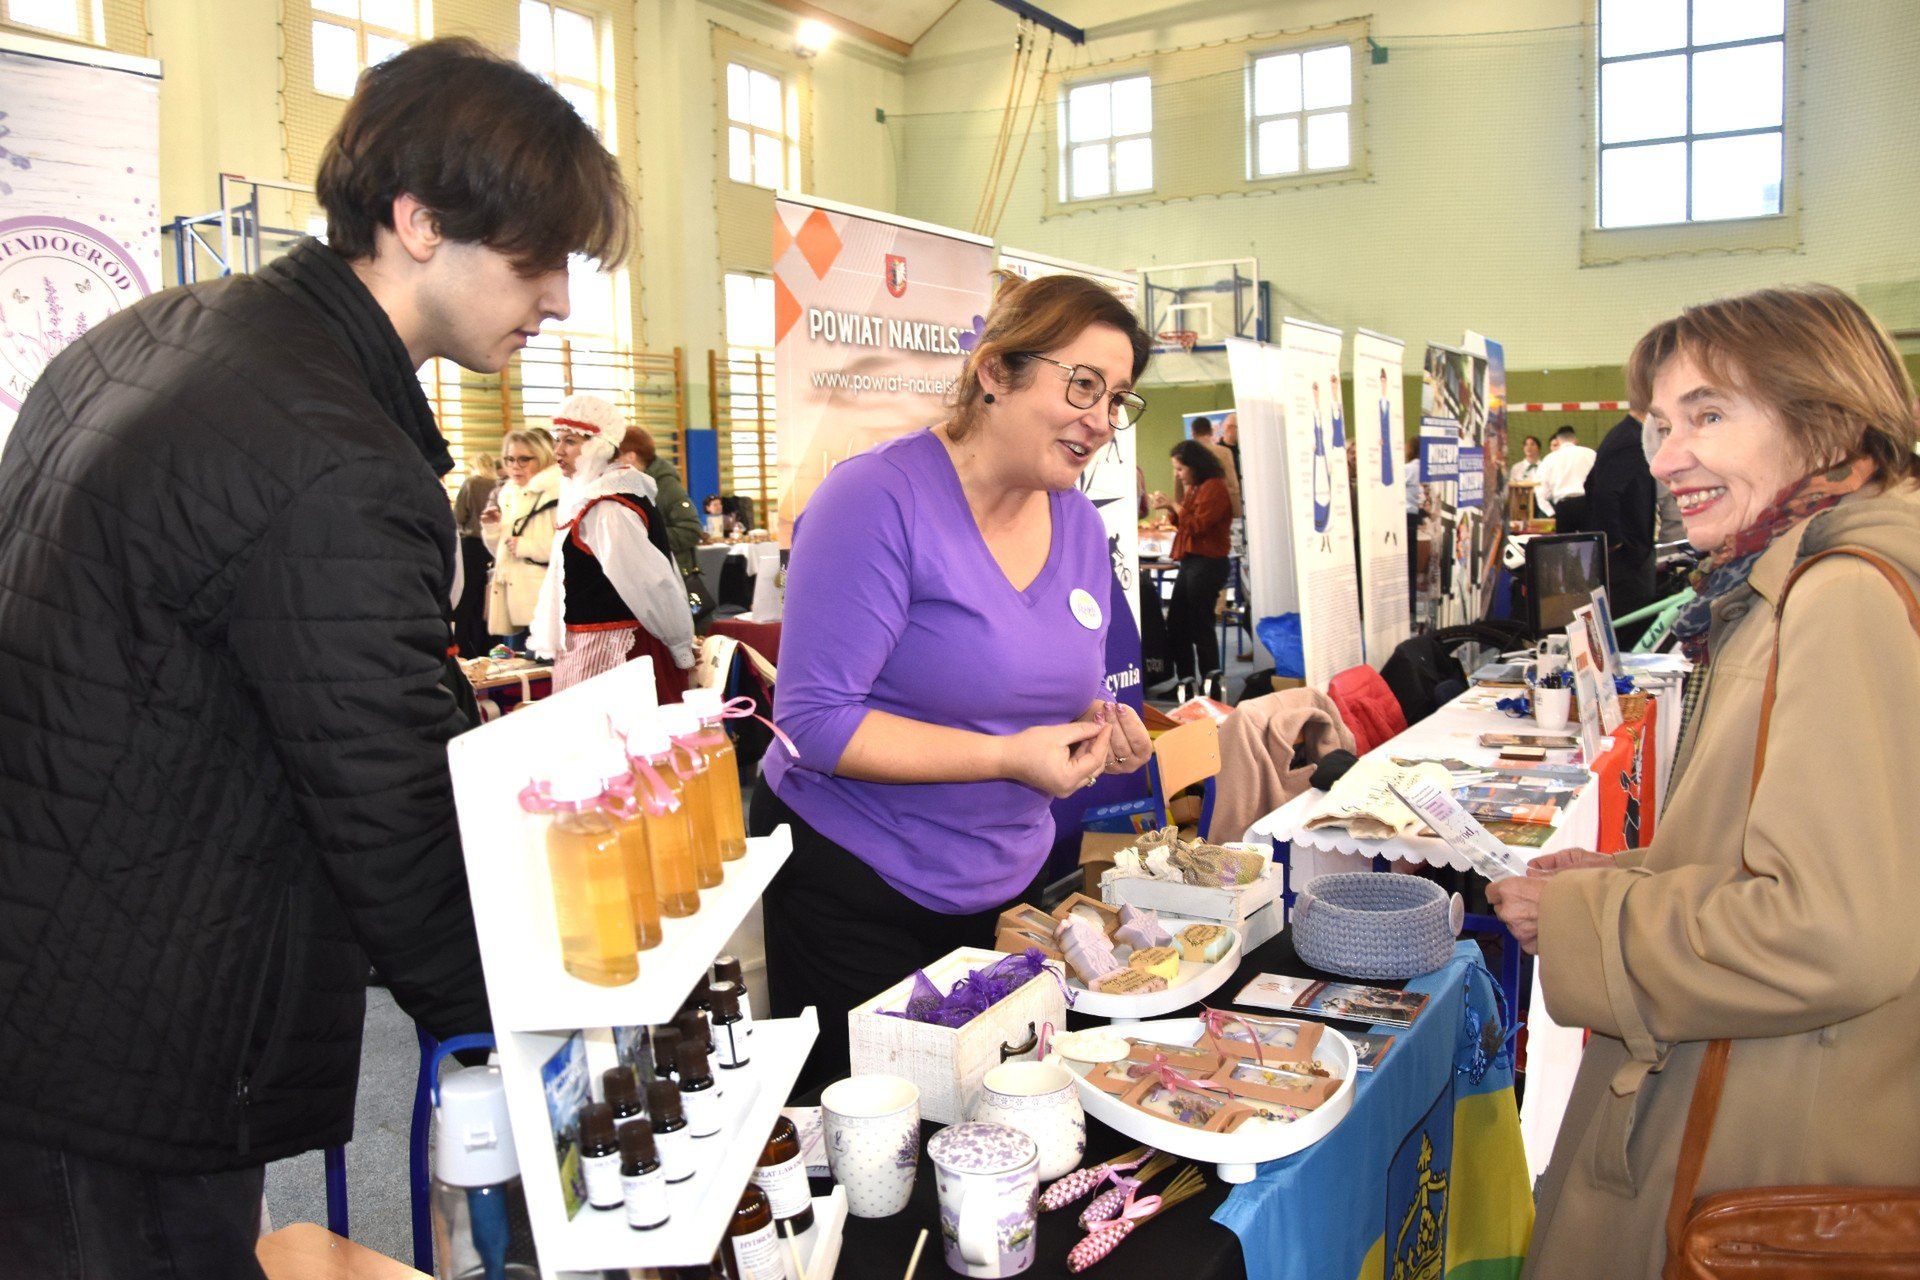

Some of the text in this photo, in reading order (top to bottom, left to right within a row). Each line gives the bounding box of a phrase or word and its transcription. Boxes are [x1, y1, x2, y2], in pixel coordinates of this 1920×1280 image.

[0, 235, 131, 291] ENDOGRÓD
[809, 308, 976, 356] POWIAT NAKIELS
[1105, 662, 1141, 698] cynia
